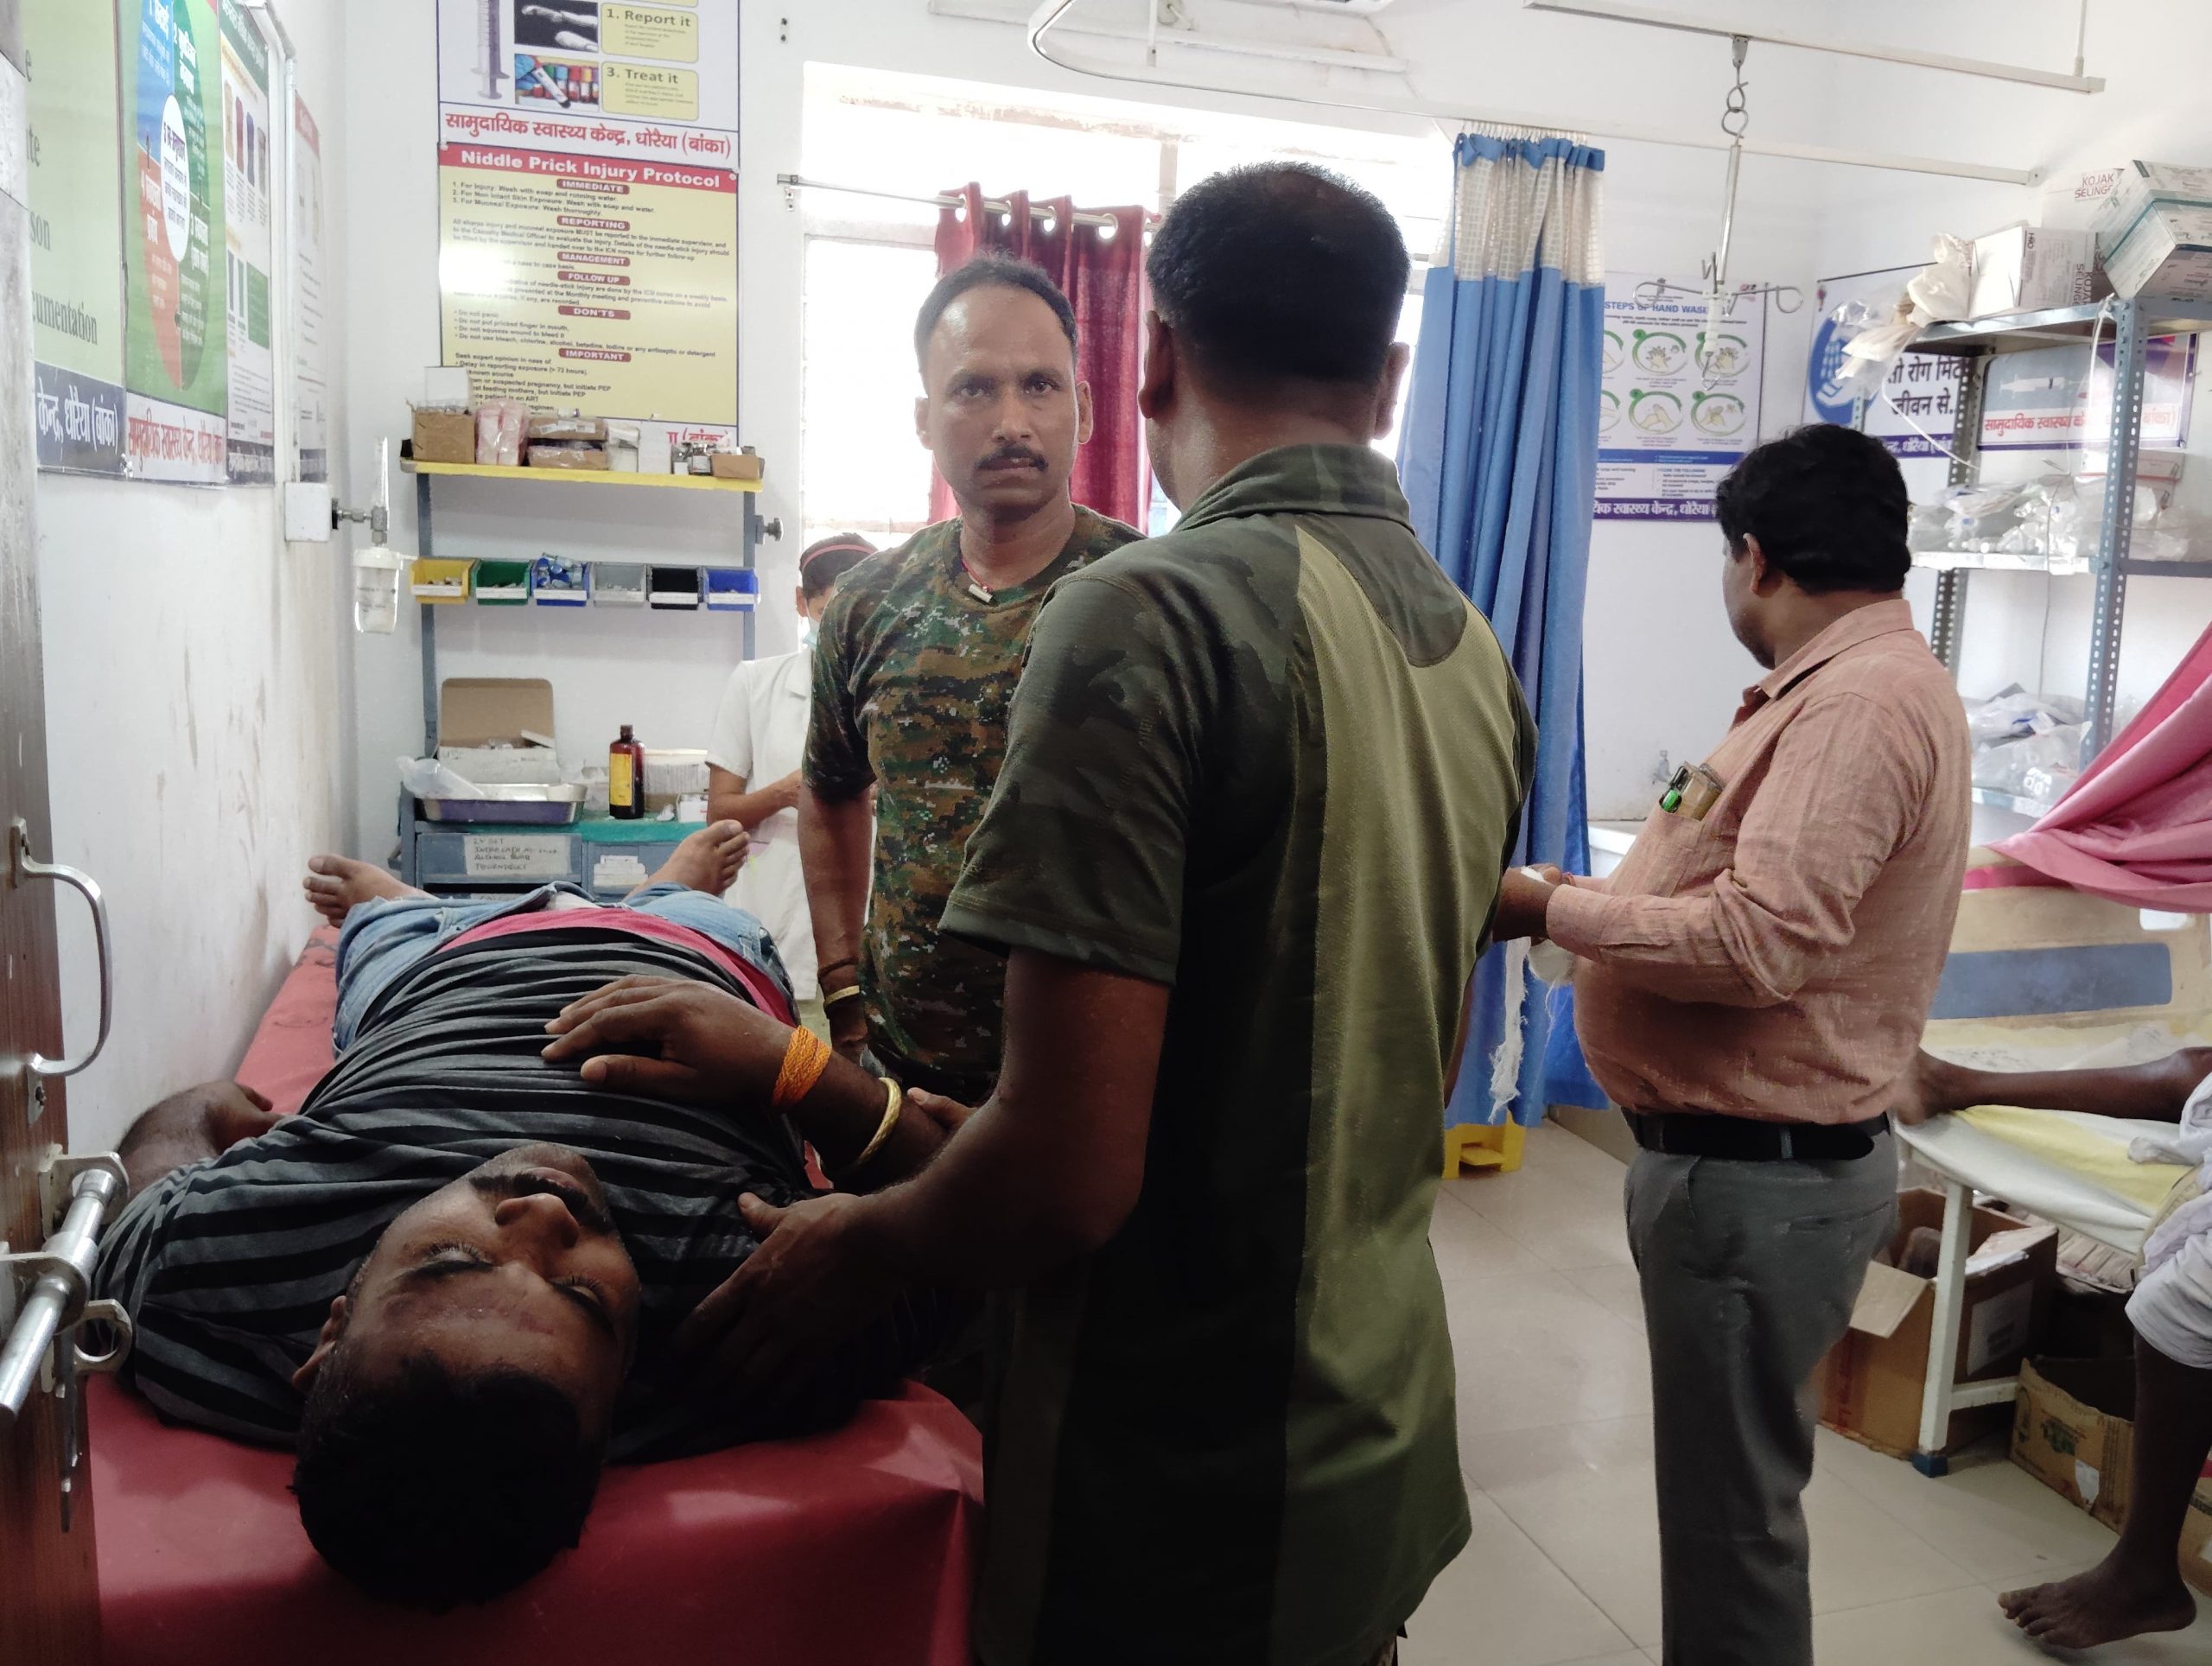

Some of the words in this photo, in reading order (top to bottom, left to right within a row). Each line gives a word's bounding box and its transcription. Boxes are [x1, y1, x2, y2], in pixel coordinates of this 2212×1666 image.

[607, 9, 619, 19] 1.
[625, 10, 676, 26] Report
[680, 16, 691, 27] it
[607, 67, 620, 78] 3.
[625, 69, 664, 82] Treat
[668, 73, 679, 84] it
[446, 112, 528, 137] सामुदायिक
[533, 123, 586, 140] स्वास्थ्य
[591, 124, 631, 145] केन्द्र,
[683, 130, 731, 159] (बांका)
[461, 150, 522, 169] Niddle
[529, 155, 576, 174] Prick
[583, 159, 637, 180] Injury
[643, 164, 719, 188] Protocol
[2082, 173, 2115, 187] KOJAK
[562, 181, 624, 193] IMMEDIATE
[569, 192, 596, 201] running
[562, 218, 626, 229] REPORTING
[562, 254, 625, 264] MANAGEMENT
[569, 273, 607, 282] FOLLOW
[574, 308, 615, 318] DON'TS
[1604, 301, 1635, 310] STEPS
[1652, 304, 1679, 313] HAND
[566, 350, 624, 359] IMPORTANT
[1908, 356, 1932, 382] रोग
[2143, 407, 2175, 425] बांका)
[1984, 413, 2034, 436] सामुदायिक
[2037, 416, 2072, 429] स्वास्थ्य
[1614, 503, 1649, 515] स्वास्थ्य
